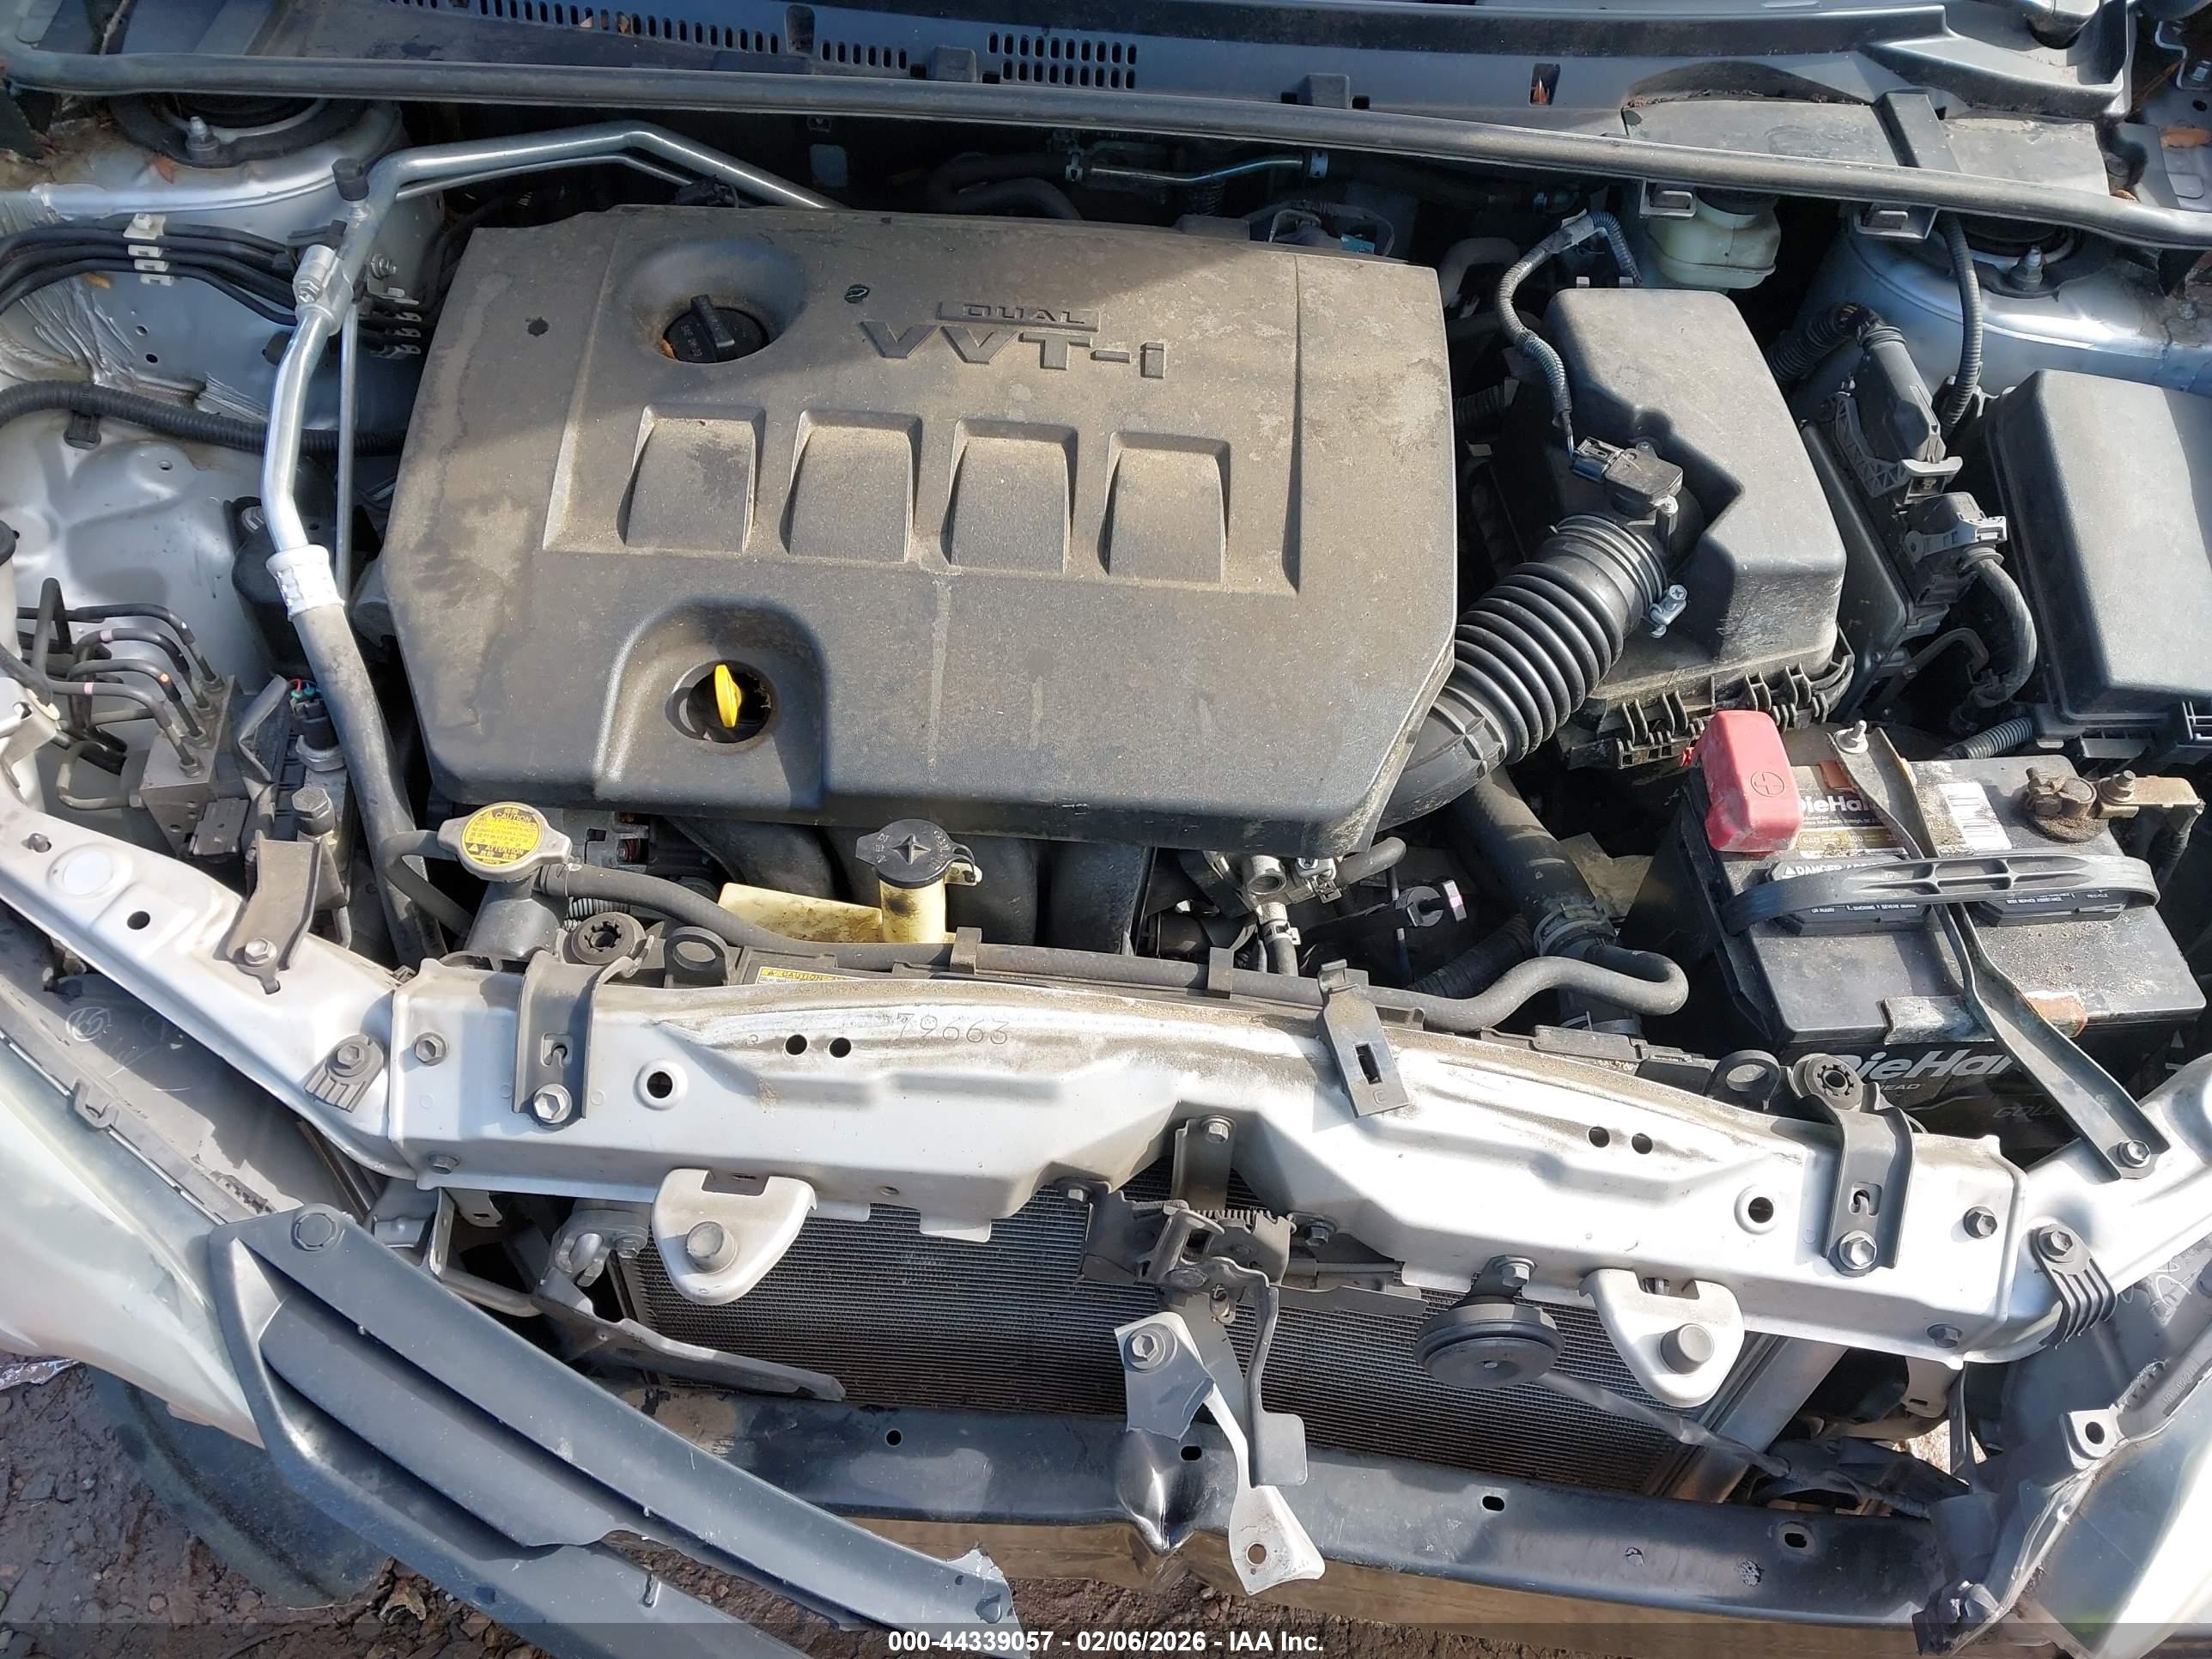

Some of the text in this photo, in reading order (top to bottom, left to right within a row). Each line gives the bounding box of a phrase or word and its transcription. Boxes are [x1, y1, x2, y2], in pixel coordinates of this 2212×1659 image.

[963, 303, 1085, 325] DUAL
[859, 320, 1165, 380] VVT-i
[495, 811, 532, 823] CAUTION
[484, 844, 524, 855] ATTENTION
[781, 970, 823, 981] CAUTION
